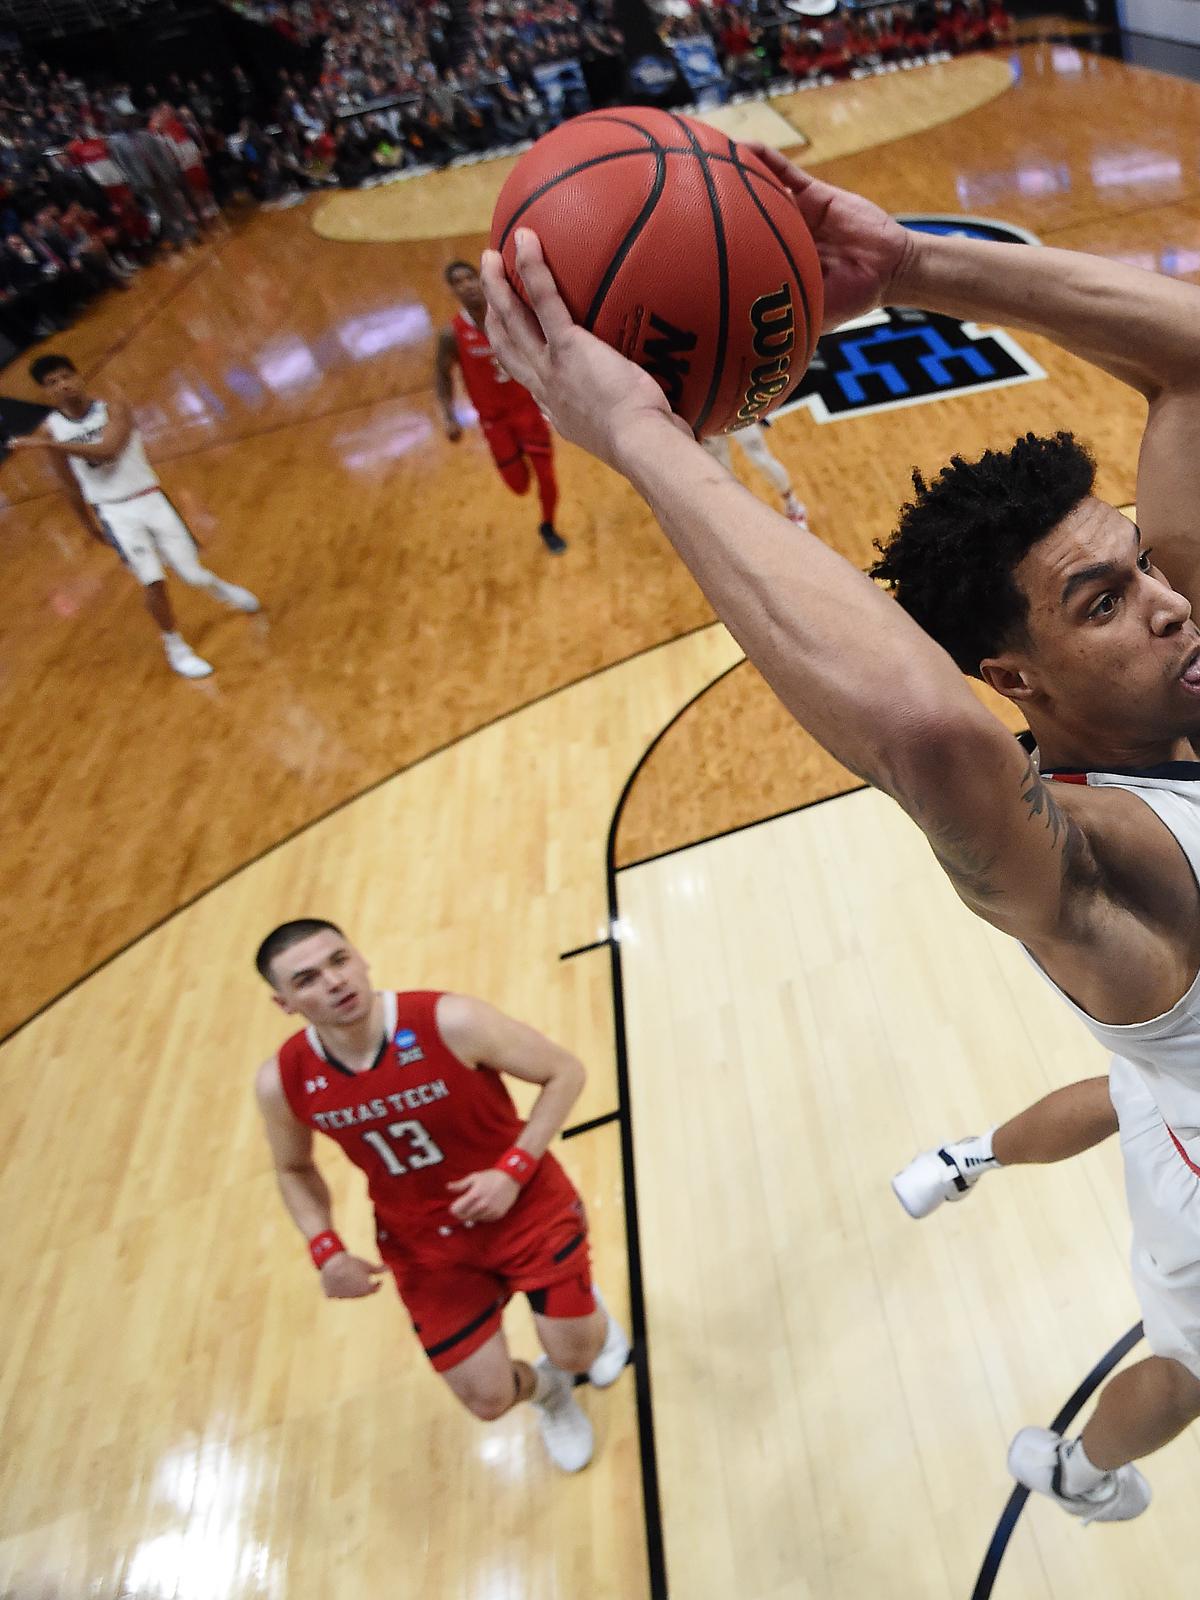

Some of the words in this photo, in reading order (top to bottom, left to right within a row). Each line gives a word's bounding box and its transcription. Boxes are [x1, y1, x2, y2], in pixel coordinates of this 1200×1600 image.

[724, 281, 795, 434] Wils
[311, 1098, 389, 1131] TEXAS
[385, 1078, 450, 1114] TECH
[361, 1119, 445, 1176] 13
